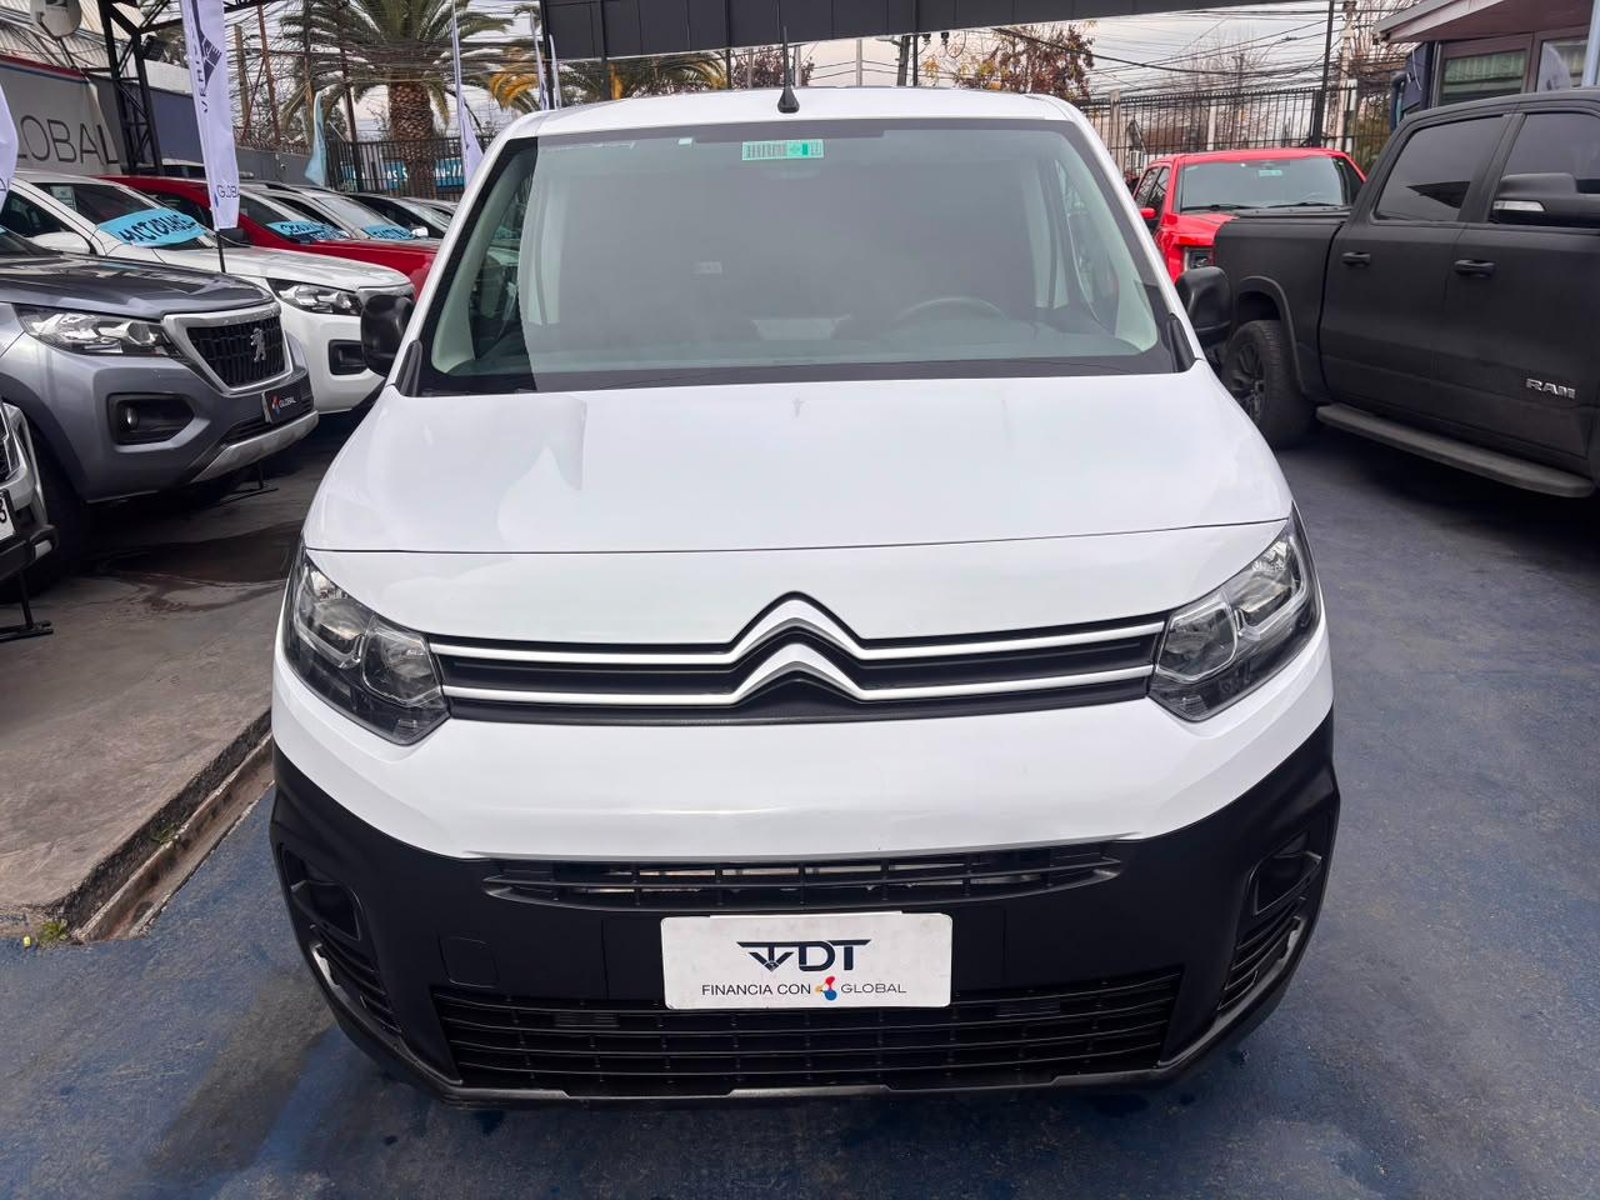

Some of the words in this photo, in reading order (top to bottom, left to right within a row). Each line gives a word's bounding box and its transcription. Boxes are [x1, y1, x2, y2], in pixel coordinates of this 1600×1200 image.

[17, 115, 119, 165] OBAL
[1526, 378, 1576, 399] RAM
[701, 984, 773, 996] FINANCIA
[776, 983, 812, 995] CON
[840, 983, 907, 994] GLOBAL
